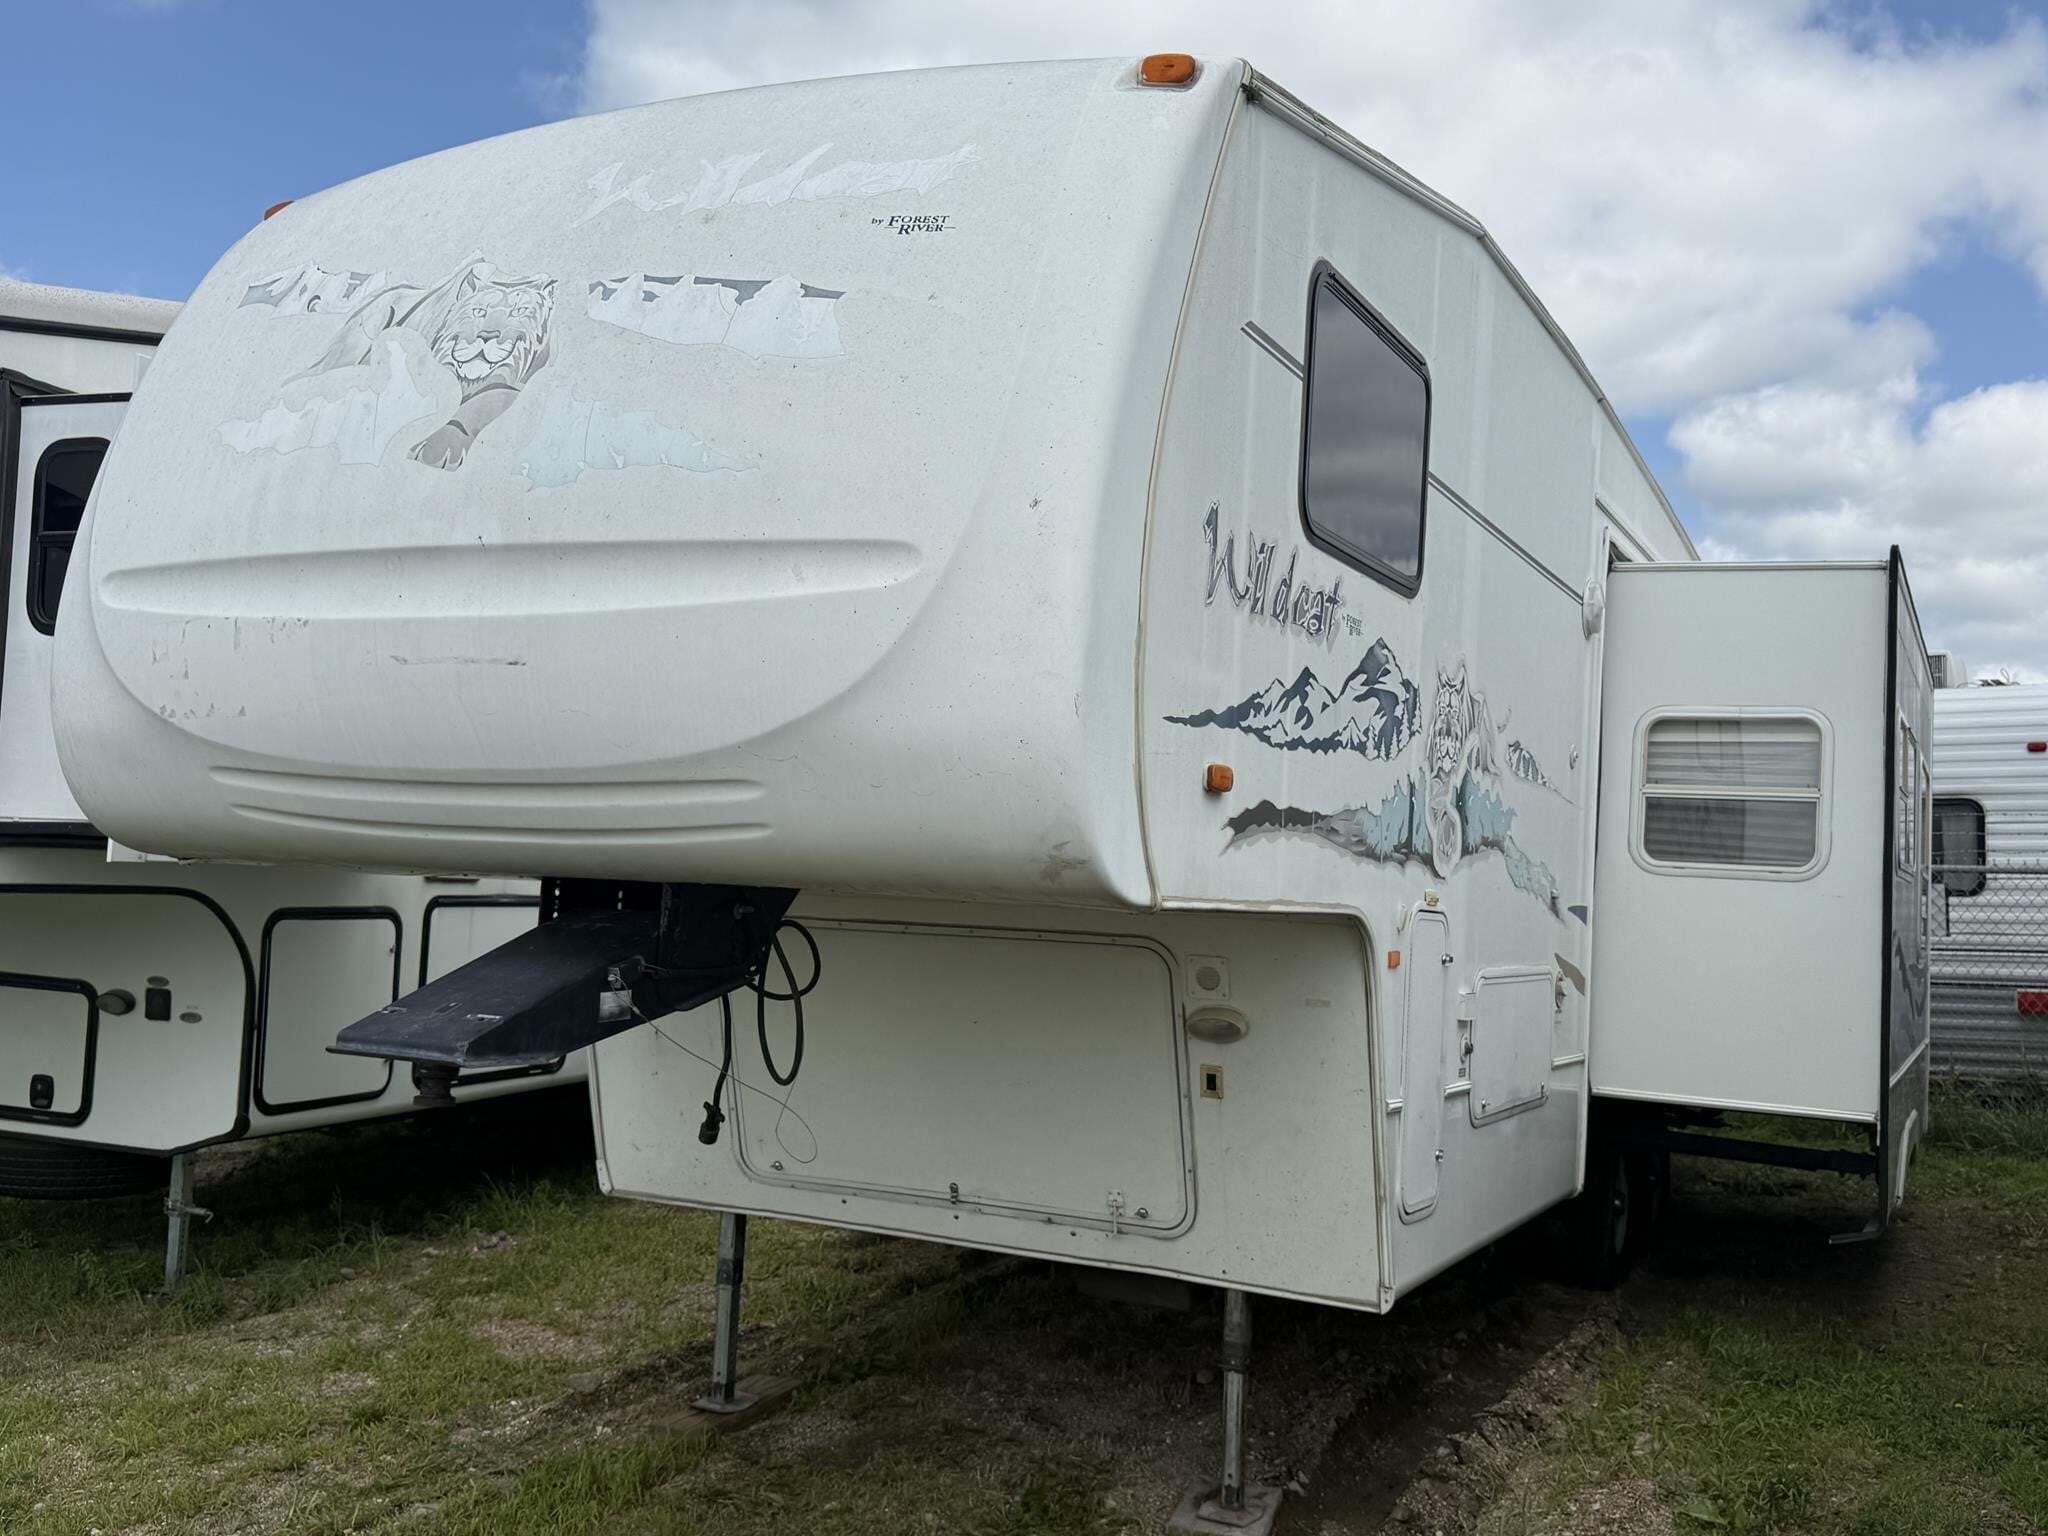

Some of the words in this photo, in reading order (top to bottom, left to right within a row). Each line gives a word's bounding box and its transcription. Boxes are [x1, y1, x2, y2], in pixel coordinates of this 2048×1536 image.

[871, 217, 884, 225] by
[888, 215, 949, 226] FOREST
[897, 224, 944, 235] RIVER
[1203, 500, 1342, 644] Wildcat
